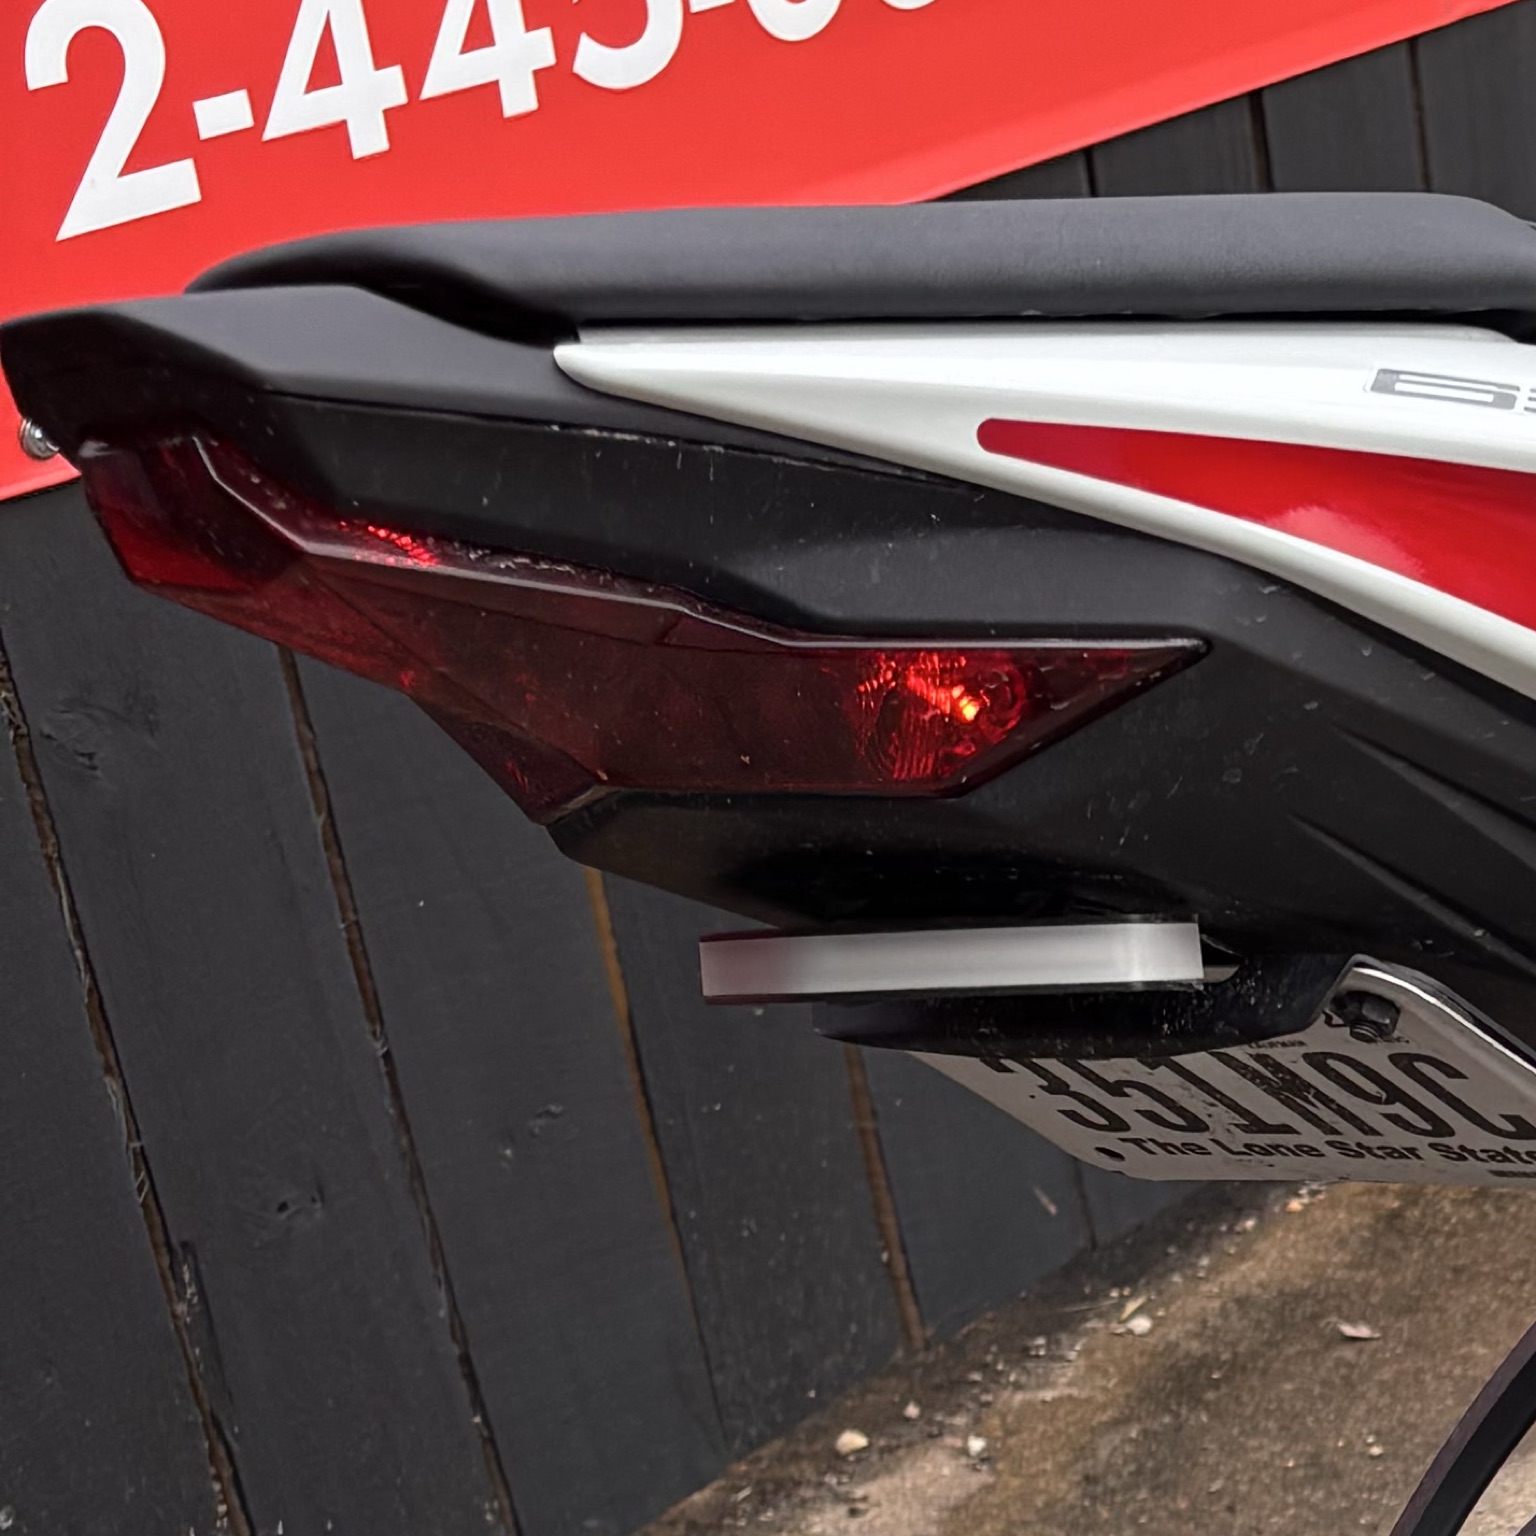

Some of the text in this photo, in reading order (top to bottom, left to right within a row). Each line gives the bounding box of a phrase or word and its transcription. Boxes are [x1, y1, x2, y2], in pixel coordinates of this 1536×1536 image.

[1117, 1136, 1208, 1158] The
[1213, 1137, 1320, 1160] Lone
[1326, 1139, 1420, 1163] Star
